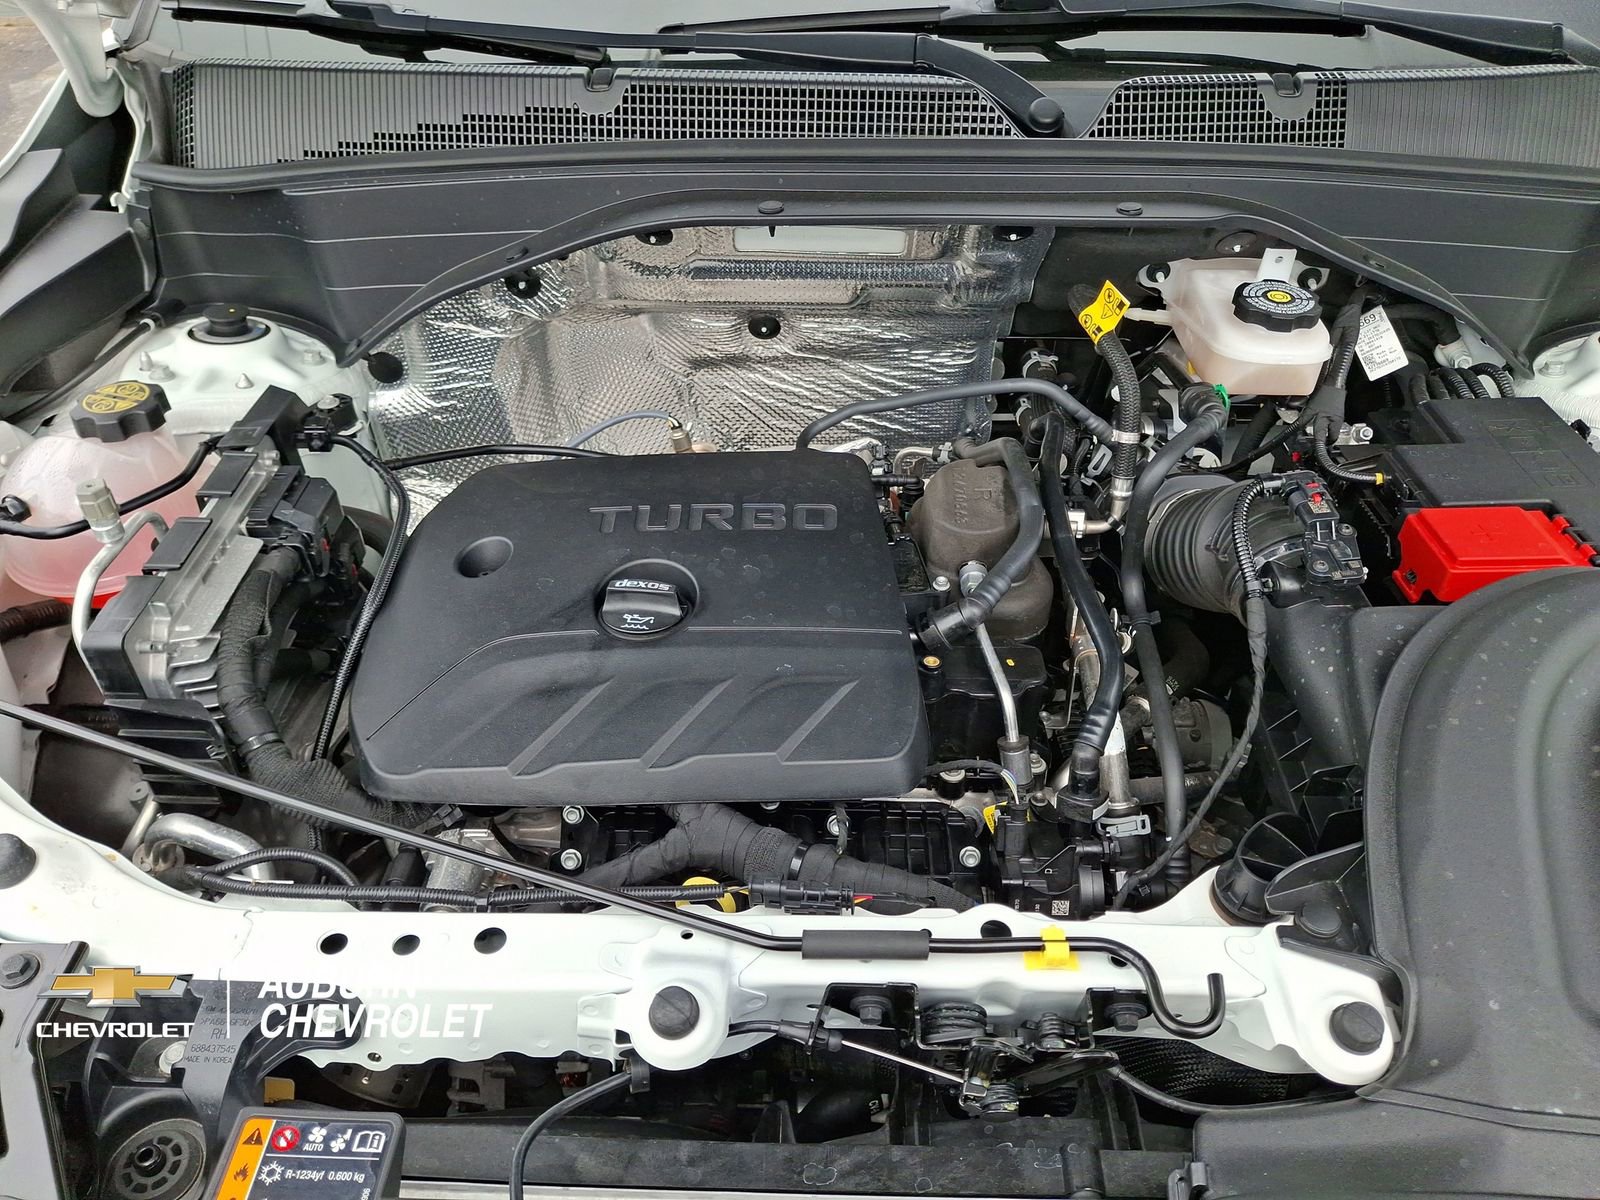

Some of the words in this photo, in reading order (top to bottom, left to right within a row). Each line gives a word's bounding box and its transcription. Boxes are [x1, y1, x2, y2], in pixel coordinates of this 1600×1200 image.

[588, 503, 838, 534] TURBO
[614, 579, 670, 591] dexos
[210, 1027, 228, 1040] RH
[183, 1055, 201, 1063] MADE
[212, 1056, 233, 1064] KOREA
[302, 1143, 324, 1152] AUTO
[285, 1169, 325, 1182] R-1234yf
[328, 1171, 353, 1182] 0.600
[353, 1172, 366, 1184] kg
